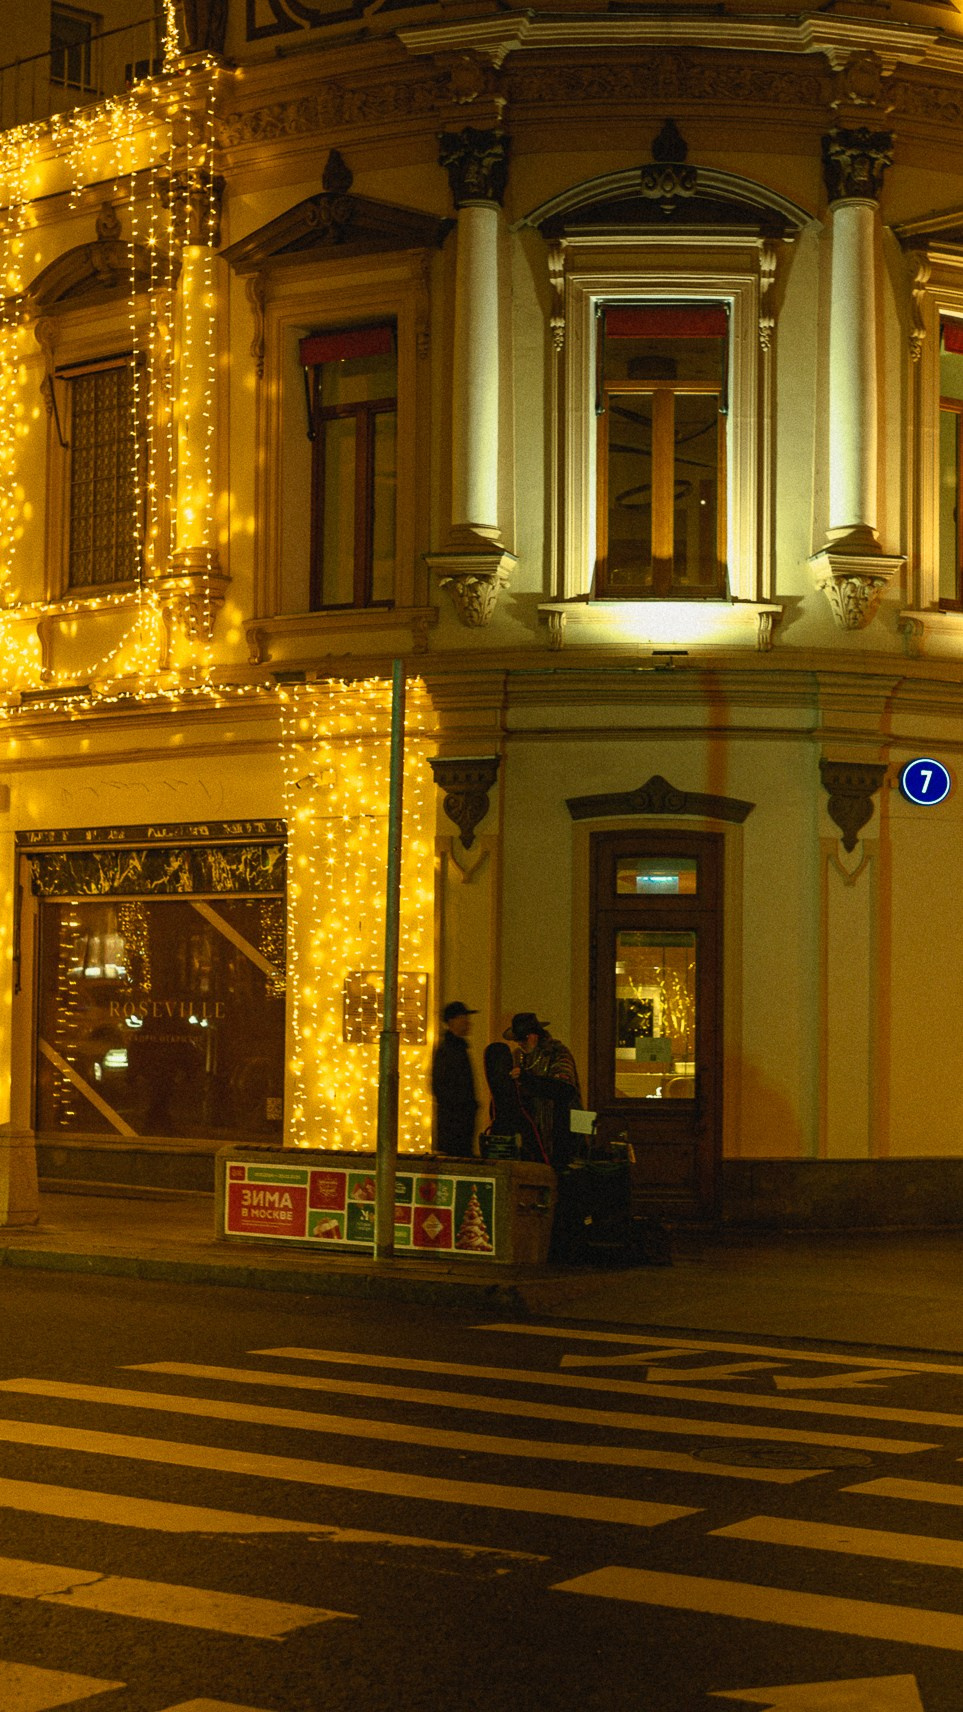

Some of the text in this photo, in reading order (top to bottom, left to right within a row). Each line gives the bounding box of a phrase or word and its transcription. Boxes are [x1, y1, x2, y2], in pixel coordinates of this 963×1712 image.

[920, 769, 933, 794] 7
[109, 1001, 226, 1018] ROSEVILLE
[241, 1189, 293, 1209] ЗИМА
[241, 1208, 294, 1221] В МОСКВЕ
